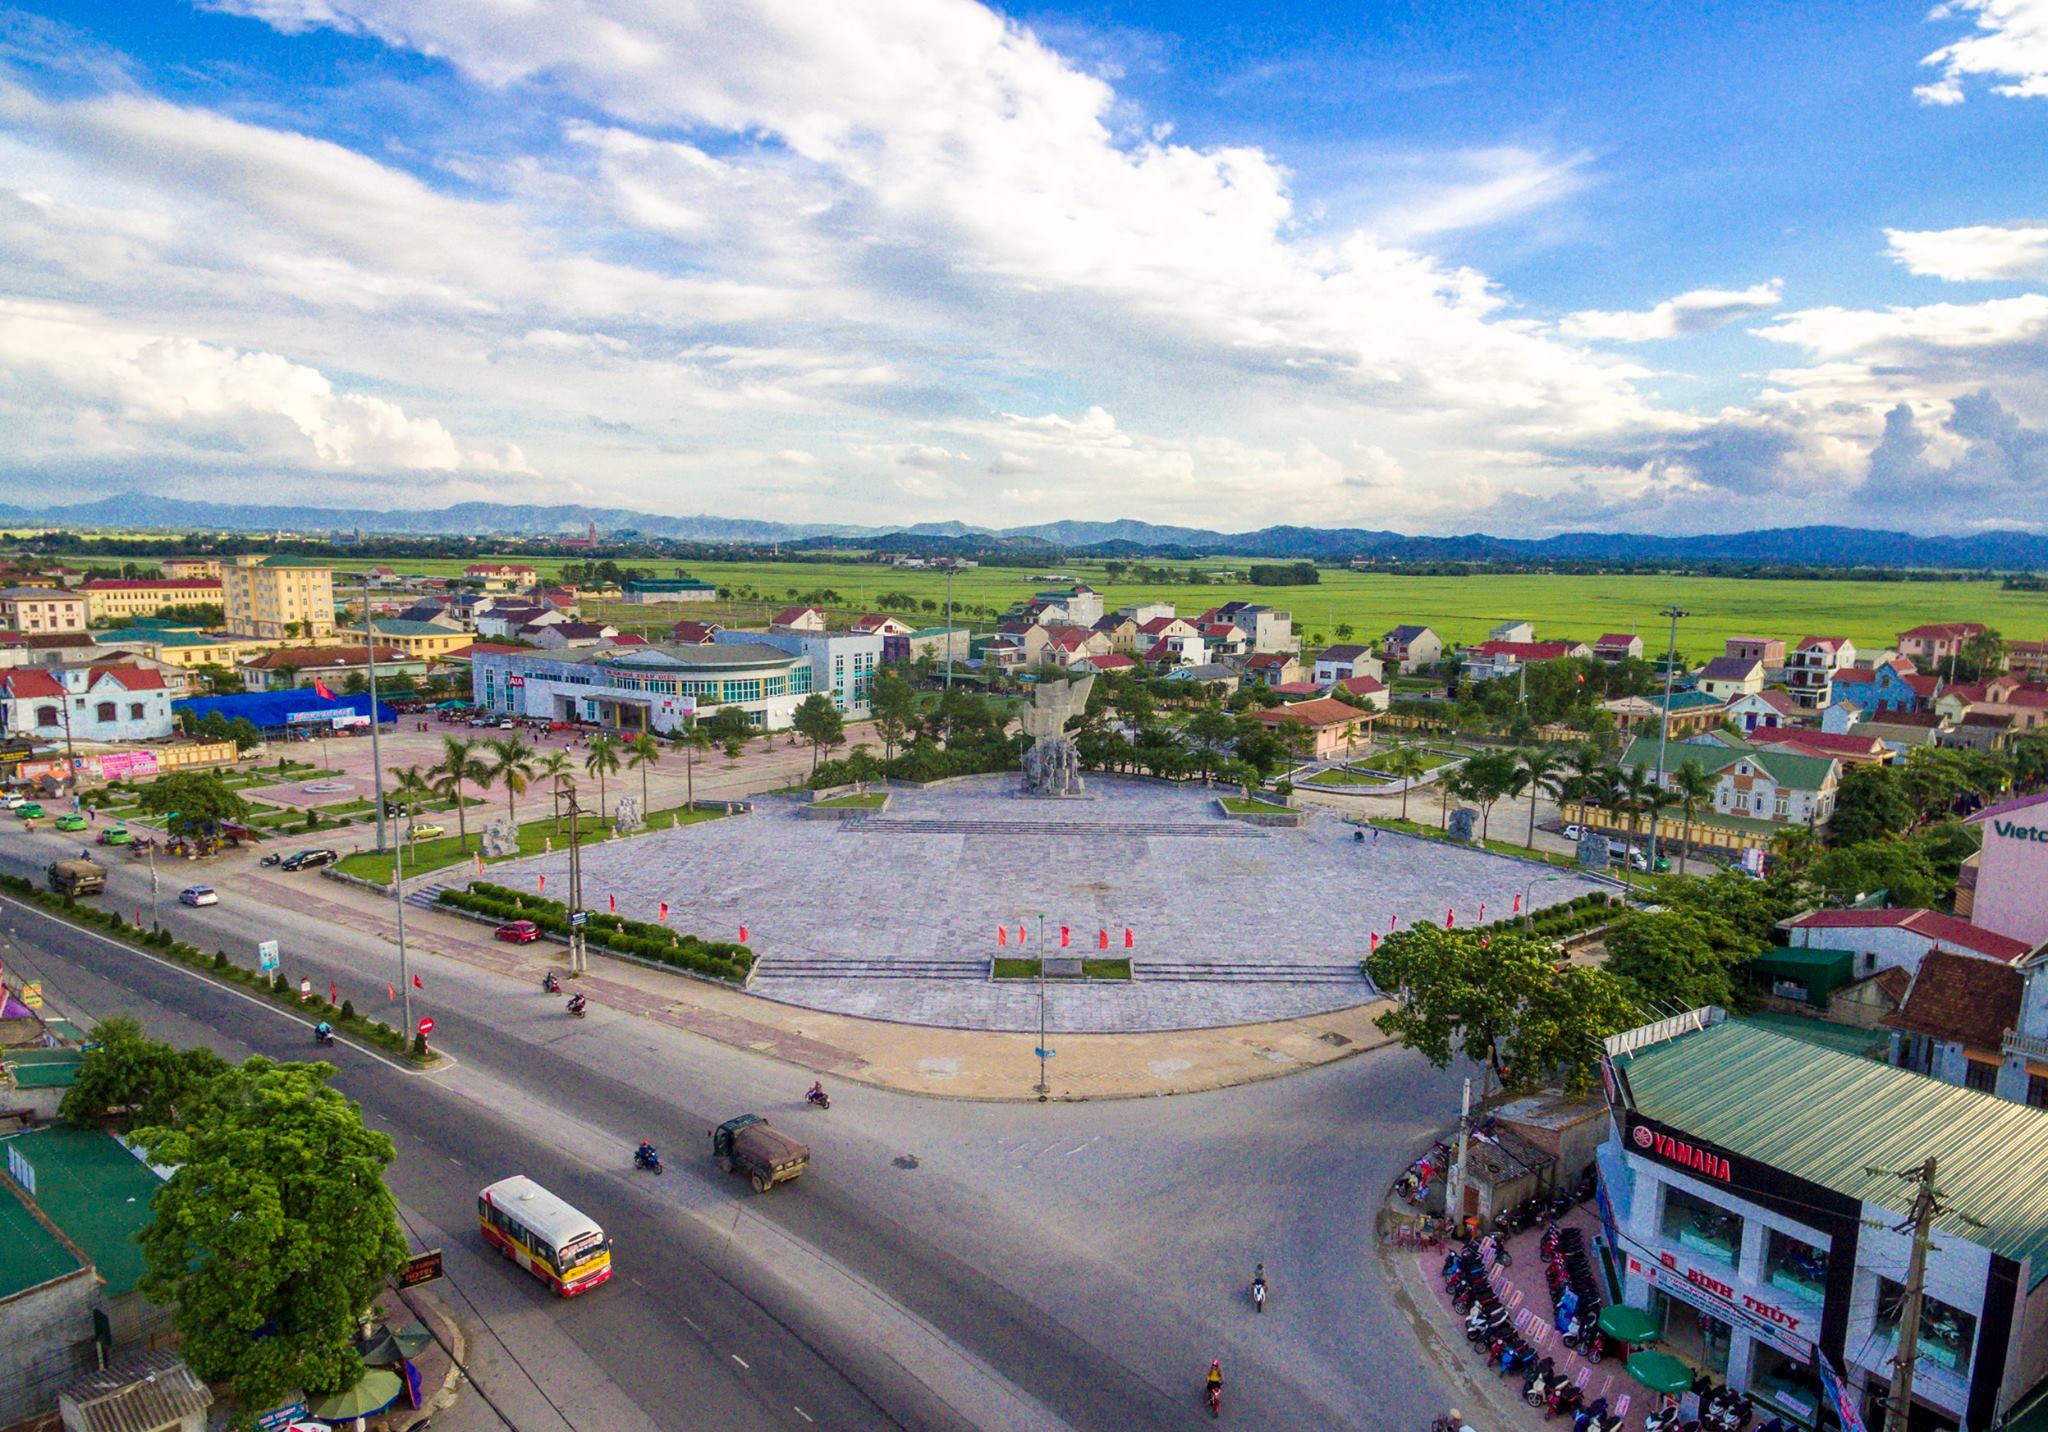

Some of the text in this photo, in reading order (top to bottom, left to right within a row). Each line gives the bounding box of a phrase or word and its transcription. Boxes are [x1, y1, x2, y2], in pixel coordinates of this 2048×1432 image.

[510, 677, 523, 685] AIA
[1653, 1132, 1731, 1182] YAMAHA
[405, 1267, 433, 1281] HOTEL
[1687, 1268, 1734, 1300] BÌNH
